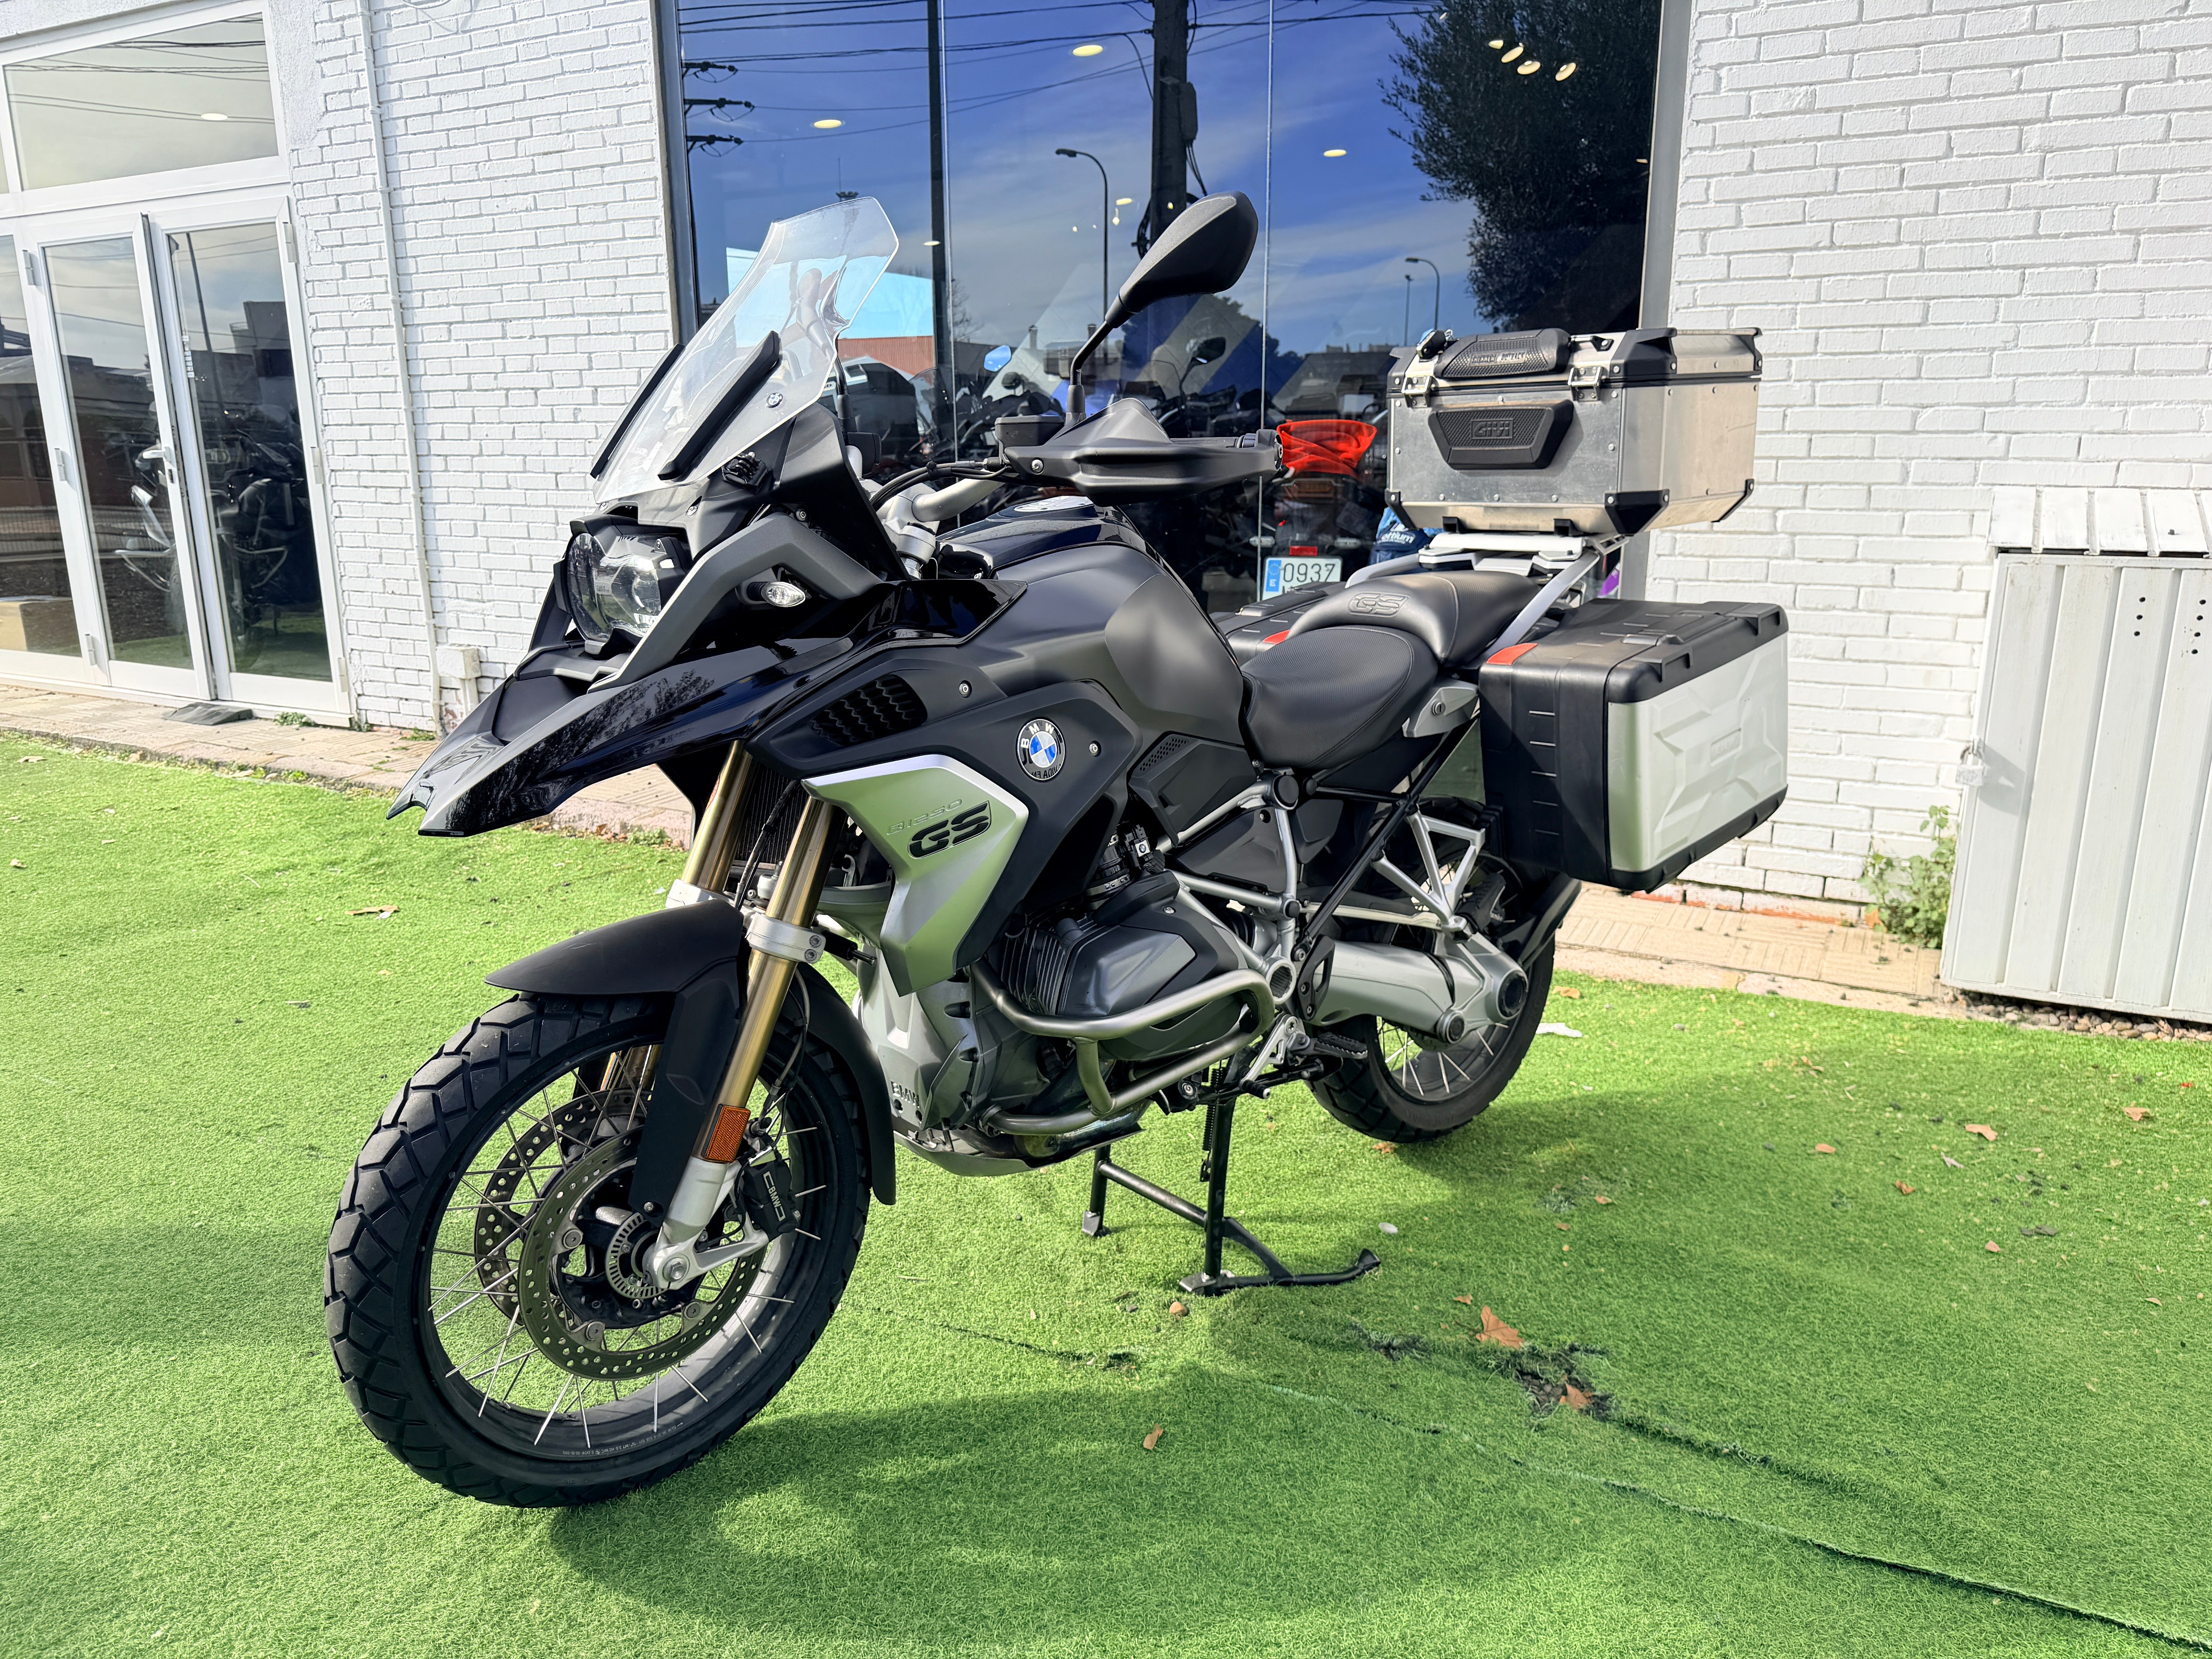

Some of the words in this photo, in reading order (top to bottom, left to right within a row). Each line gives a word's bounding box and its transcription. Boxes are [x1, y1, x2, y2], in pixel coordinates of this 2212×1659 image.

[1474, 421, 1510, 437] GIVI
[1283, 563, 1335, 582] 0937
[1350, 592, 1406, 616] GS
[909, 802, 990, 858] GS
[890, 1080, 920, 1108] BMW
[768, 1186, 781, 1208] BMW
